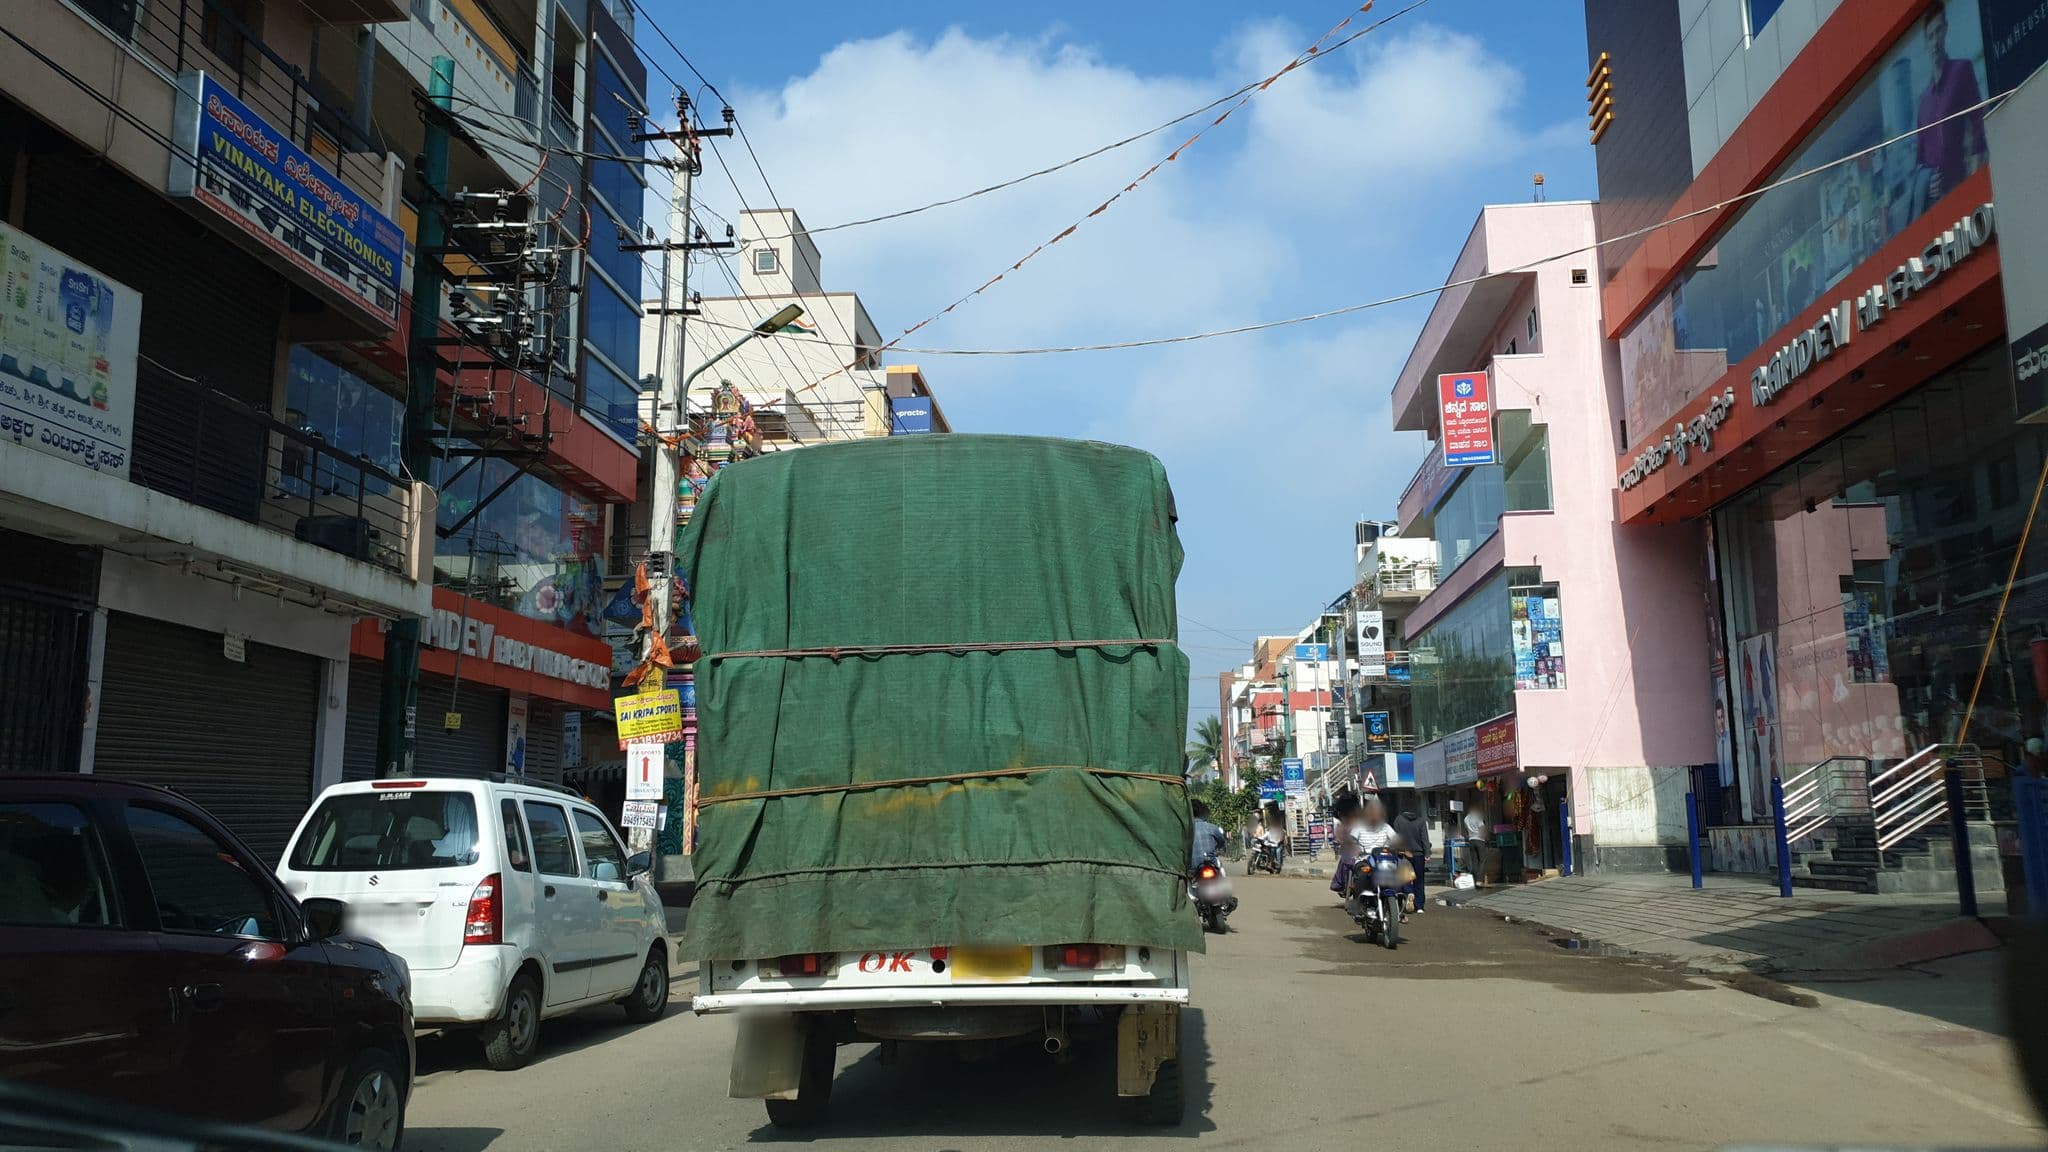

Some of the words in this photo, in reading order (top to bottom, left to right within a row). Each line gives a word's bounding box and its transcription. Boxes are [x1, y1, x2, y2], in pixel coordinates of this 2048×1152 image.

[212, 131, 295, 208] VINAYAKA
[299, 196, 393, 278] ELECTRONICS
[1750, 300, 1852, 408] RAMDEV
[620, 711, 631, 722] SAI
[634, 707, 654, 720] KRIPA
[655, 704, 678, 716] SPORTS
[858, 951, 916, 973] OK
